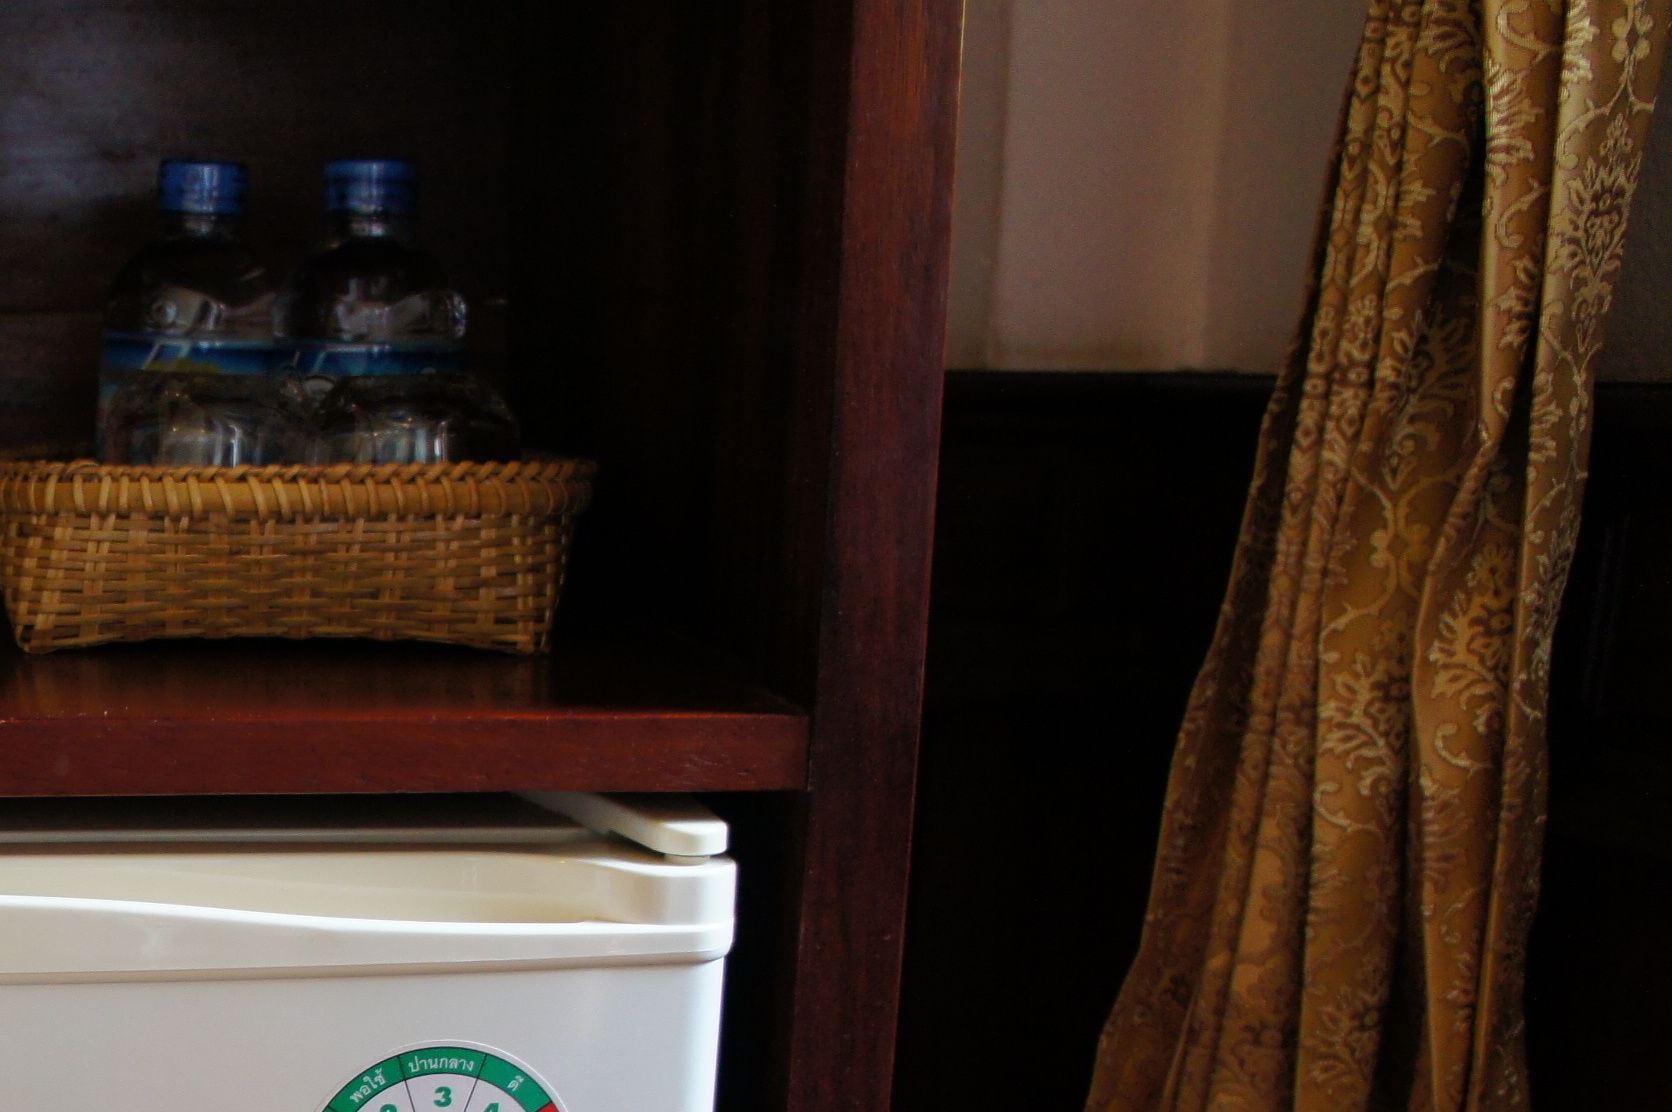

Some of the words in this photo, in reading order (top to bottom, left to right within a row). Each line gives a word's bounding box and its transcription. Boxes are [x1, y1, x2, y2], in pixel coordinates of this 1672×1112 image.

[408, 1055, 475, 1072] ปานกลาง
[349, 1067, 387, 1103] พอใช้
[507, 1074, 525, 1092] ดี
[433, 1086, 453, 1108] 3
